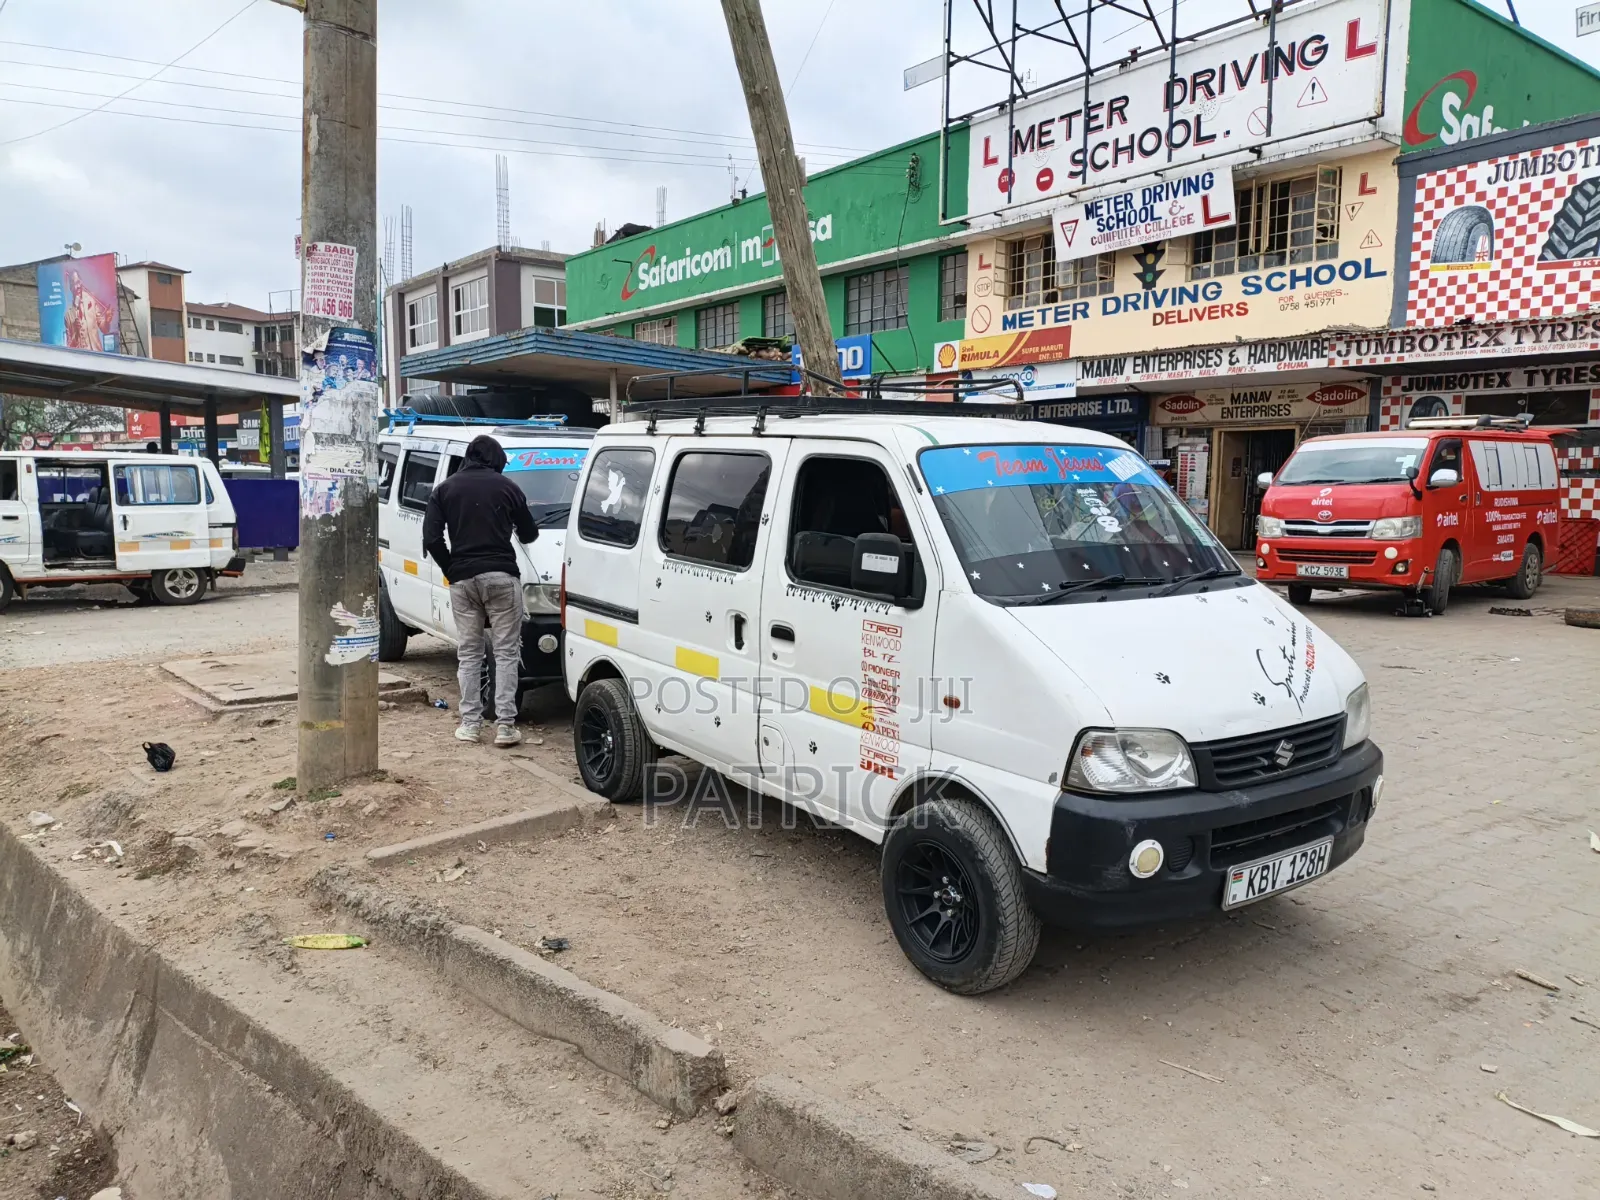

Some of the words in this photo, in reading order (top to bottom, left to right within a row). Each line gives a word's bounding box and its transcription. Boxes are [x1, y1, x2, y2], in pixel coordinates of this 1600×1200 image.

[1579, 10, 1600, 27] fir
[1345, 17, 1378, 61] L
[1012, 95, 1130, 157] METER
[1163, 34, 1329, 112] DRIVING
[983, 135, 999, 168] L
[1358, 172, 1377, 196] L
[1084, 192, 1134, 221] METER
[1142, 171, 1214, 206] DRIVING
[1201, 193, 1232, 227] L
[1096, 205, 1163, 233] SCHOOL
[1091, 223, 1141, 246] COMPUTER
[1144, 213, 1195, 234] COLLEGE
[325, 245, 354, 256] BABU
[331, 259, 341, 267] LOST
[342, 260, 354, 268] LOVER
[638, 245, 732, 290] Safaricom
[978, 253, 992, 271] L
[311, 272, 353, 280] SPIRITUALIST
[310, 291, 352, 300] PROMOTION
[311, 285, 353, 294] PROTECTION
[976, 282, 991, 293] STOP
[1002, 301, 1090, 331] METER
[1101, 281, 1223, 317] DRIVING
[1241, 257, 1387, 296] SCHOOL
[322, 299, 336, 315] 456
[338, 300, 353, 317] 966
[1278, 295, 1294, 304] FOR
[1280, 302, 1300, 312] 0758
[1304, 298, 1336, 309] 451971
[1152, 301, 1249, 327] DELIVERS
[1041, 344, 1064, 352] MARUTI
[1336, 327, 1505, 357] JUMBOTEX
[961, 350, 999, 362] RIMULA
[1081, 357, 1127, 379] MANAV
[1132, 348, 1223, 375] ENTERPRISES
[1227, 349, 1240, 366] &
[1247, 338, 1329, 365] HARDWARE
[1277, 361, 1309, 371] CHUMA
[1401, 371, 1514, 393] JUMBOTEX
[1523, 361, 1600, 387] TYRES
[1230, 390, 1272, 405] MANAV
[1314, 390, 1358, 402] Sadolin
[1038, 402, 1102, 419] ENTERPRISE
[1106, 399, 1133, 414] LTD.
[1165, 400, 1200, 410] Sadolin
[1221, 403, 1291, 419] ENTERPRISES
[1323, 407, 1344, 415] paints
[518, 451, 576, 468] Team
[977, 450, 1048, 478] Team
[1044, 447, 1105, 480] Jesus
[1311, 497, 1333, 506] airtel
[1443, 511, 1458, 526] airtel
[1485, 510, 1501, 522] 100%
[1543, 509, 1558, 524] airtel
[1304, 565, 1322, 576] KCZ
[1324, 565, 1346, 577] 593E
[866, 622, 899, 635] TRD
[861, 633, 901, 651] KENWOOD
[1305, 642, 1316, 670] SUZUKI
[868, 664, 900, 679] PIONEER
[1299, 674, 1312, 703] Produced
[861, 712, 876, 722] Sony
[878, 718, 900, 728] Mobile
[860, 731, 900, 754] KENWOOD
[863, 748, 895, 763] TRD
[860, 758, 898, 781] JBL
[1246, 859, 1283, 898] KBV
[1286, 845, 1328, 885] 128H
